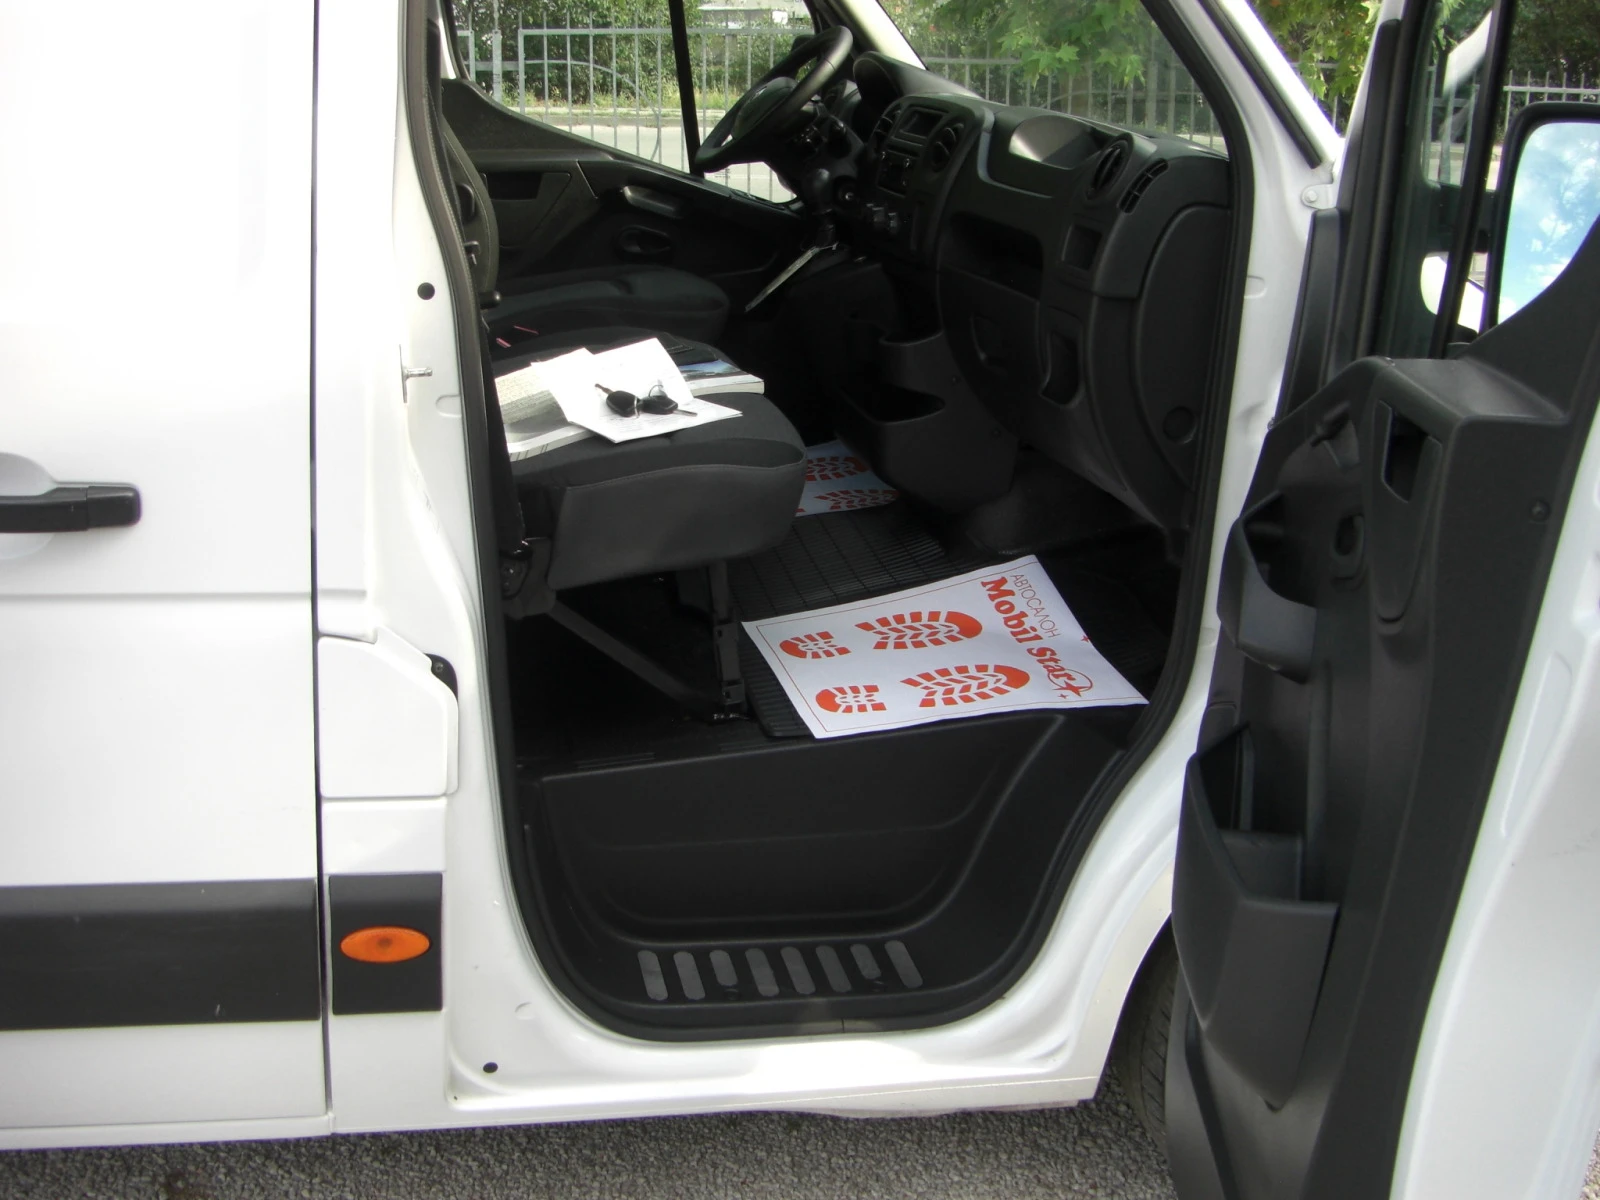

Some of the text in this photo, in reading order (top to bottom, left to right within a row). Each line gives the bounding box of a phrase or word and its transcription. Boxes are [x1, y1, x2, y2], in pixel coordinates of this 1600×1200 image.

[981, 576, 1076, 682] Mobil Star
[1011, 574, 1060, 638] АВТОСАЛОН
